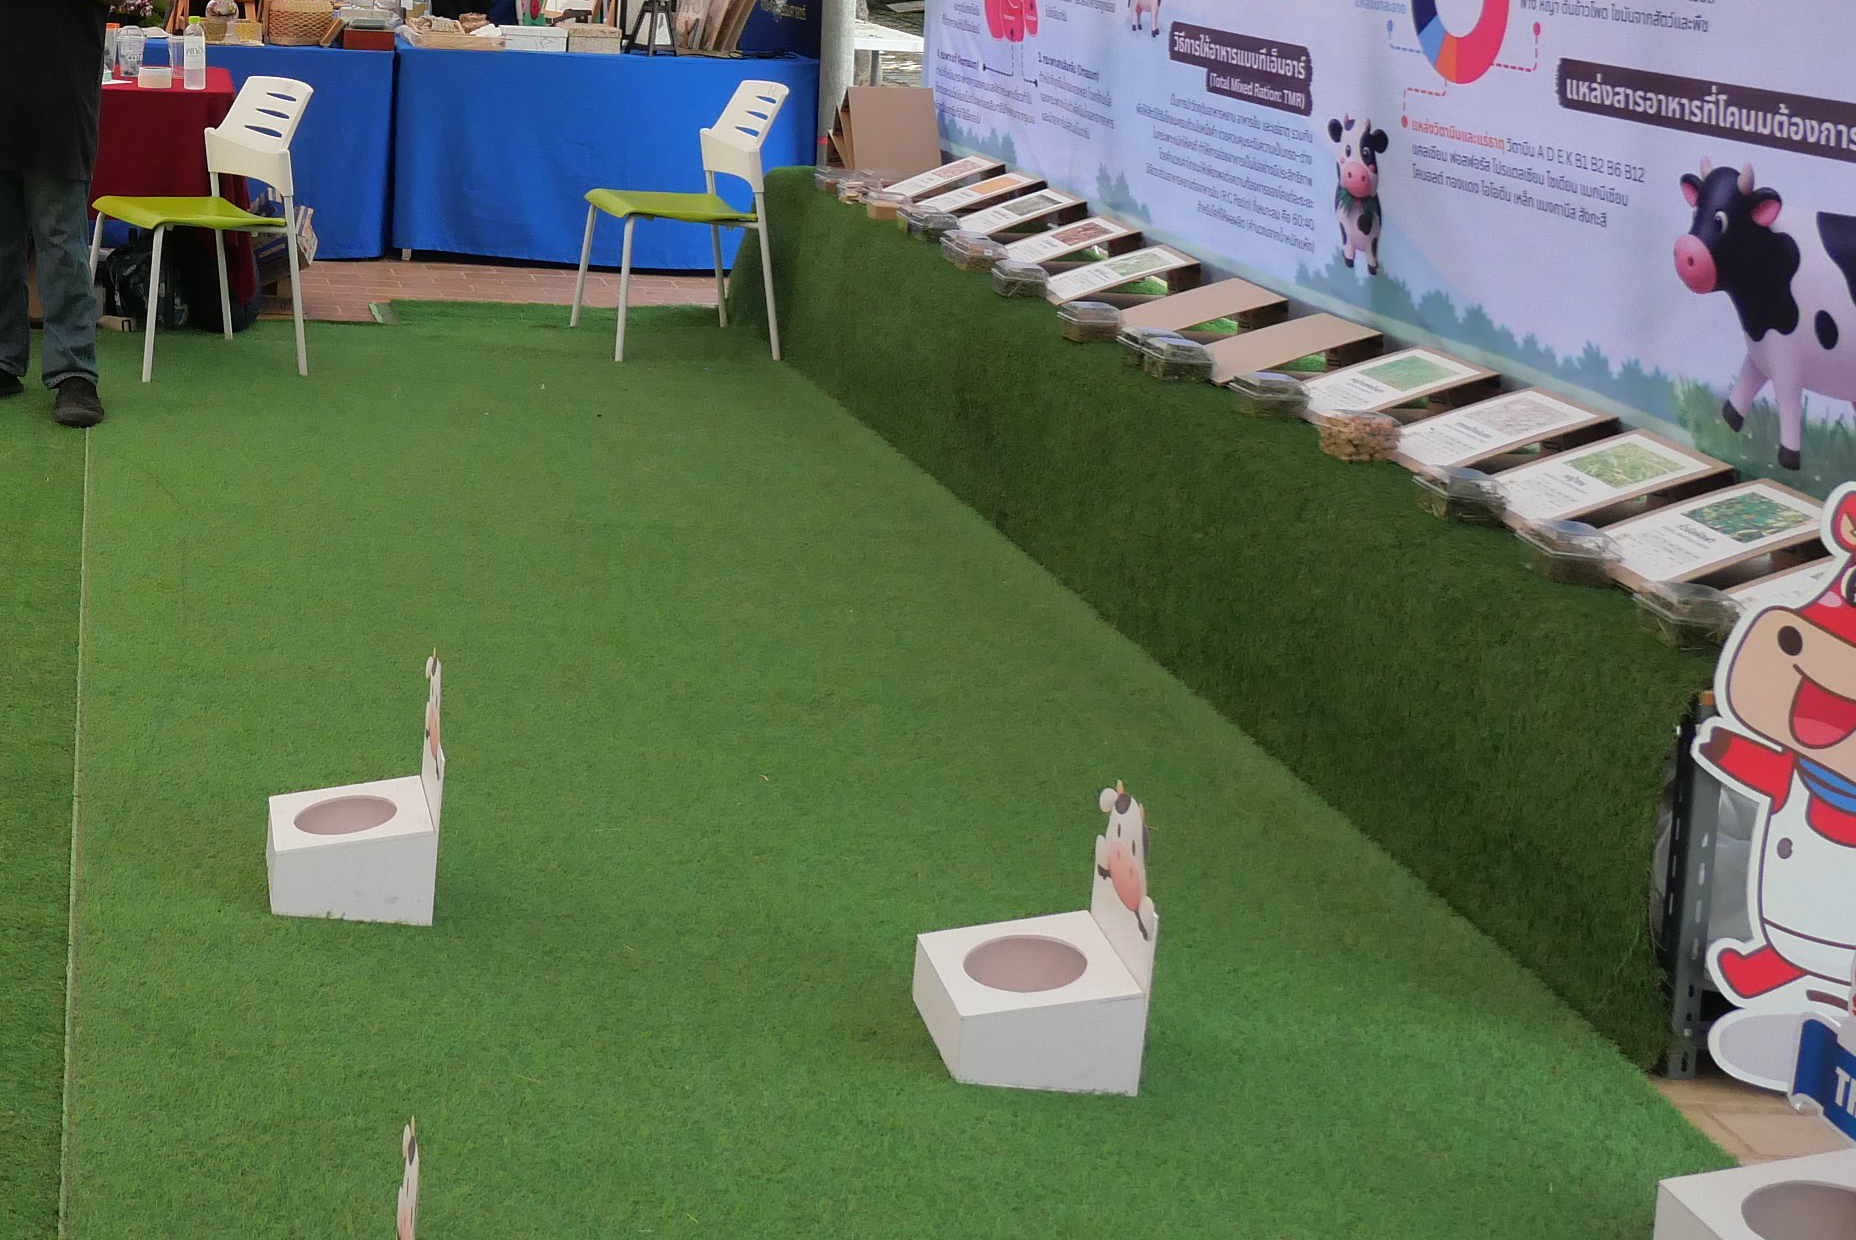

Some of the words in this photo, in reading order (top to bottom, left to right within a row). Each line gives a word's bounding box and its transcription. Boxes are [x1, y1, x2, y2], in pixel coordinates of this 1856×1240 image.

[1173, 31, 1306, 79] วิธีการให้อาหารแบบทีเอ็มอาร์
[1209, 72, 1230, 93] (Total
[1230, 78, 1253, 96] Mixed
[1283, 90, 1305, 110] TMR)
[1537, 145, 1544, 159] A
[1546, 146, 1555, 162] D
[1557, 149, 1564, 164] E
[1566, 151, 1573, 166] K
[1575, 153, 1588, 170] B1
[1590, 156, 1604, 173] B2
[1607, 160, 1621, 177] B6
[1624, 164, 1645, 183] B12
[1292, 214, 1314, 231] 60:40
